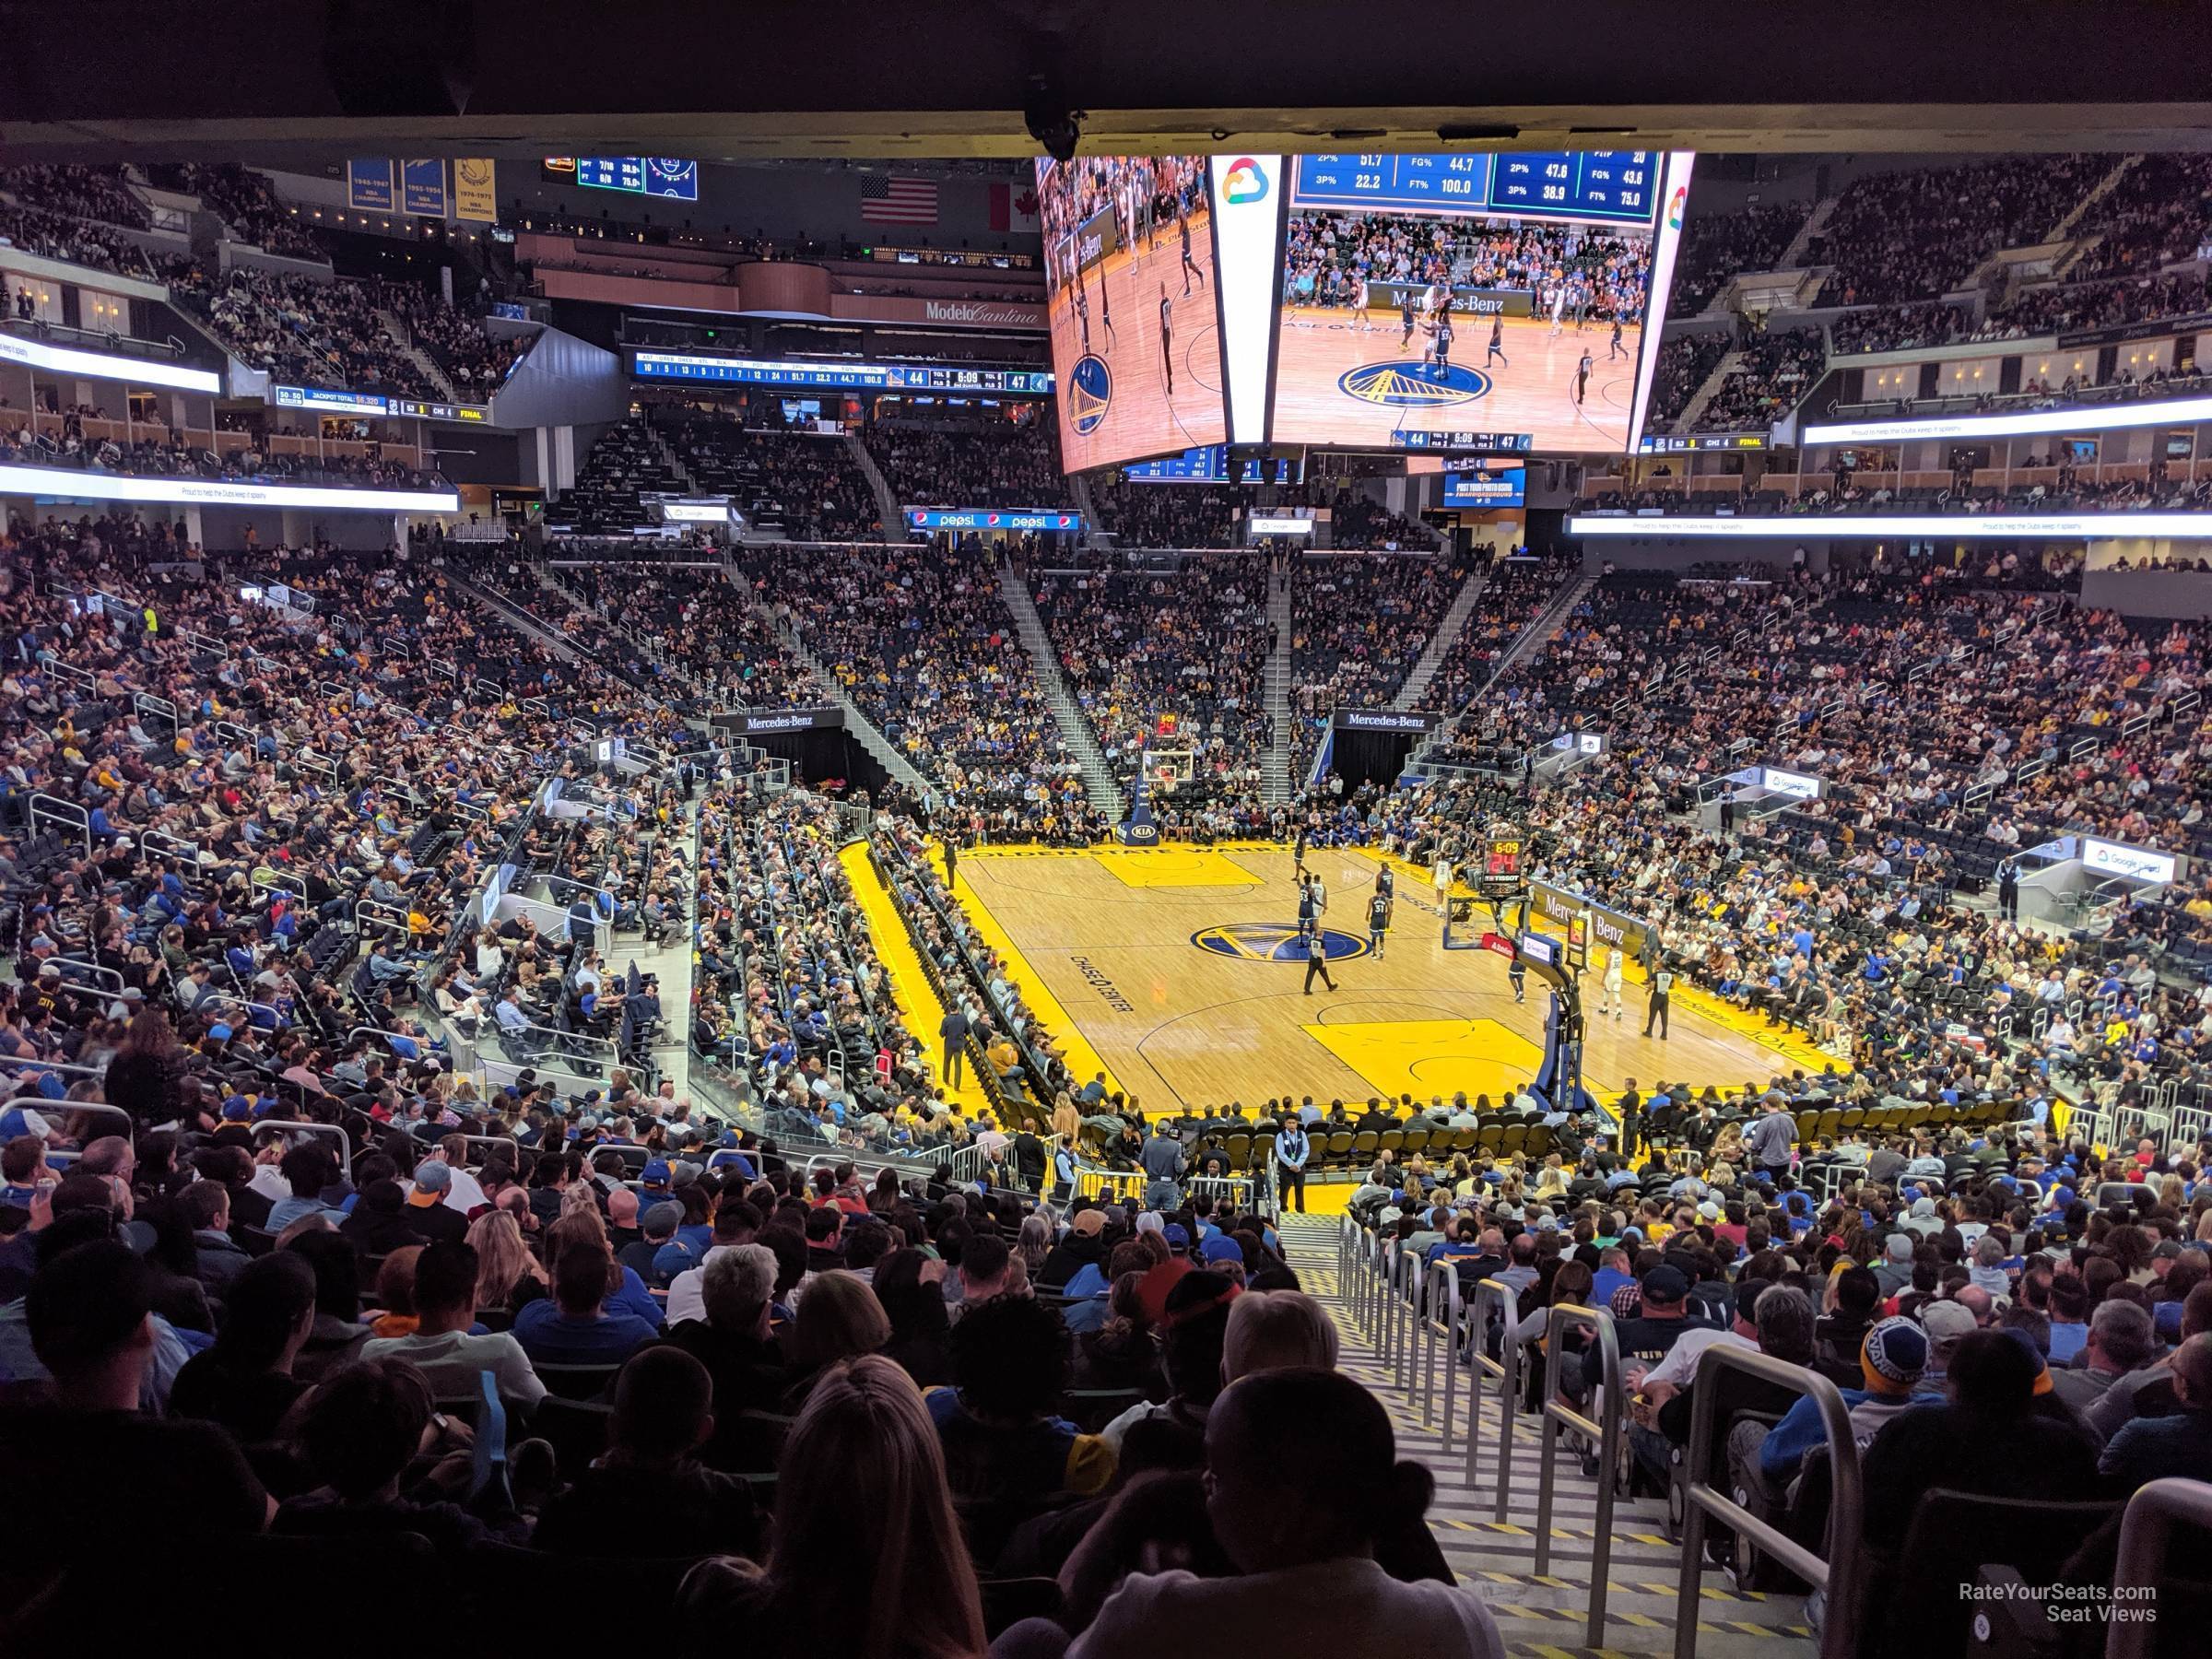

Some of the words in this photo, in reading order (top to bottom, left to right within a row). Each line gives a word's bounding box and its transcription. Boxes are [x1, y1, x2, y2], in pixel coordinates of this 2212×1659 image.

[1360, 155, 1382, 166] 51.7
[1411, 158, 1432, 167] FG%
[1450, 158, 1474, 171] 44.7
[1633, 152, 1645, 164] 20
[1510, 164, 1529, 173] 2P%
[1546, 164, 1568, 178] 47.6
[1592, 171, 1609, 180] FG%
[1623, 171, 1642, 184] 43.6
[1315, 175, 1336, 184] 3P%
[1355, 174, 1381, 189] 22.2
[1409, 180, 1429, 189] FT%
[1441, 179, 1471, 194] 100.0
[1508, 186, 1527, 195] 3P%
[1543, 186, 1565, 200] 38.9
[1589, 192, 1606, 201] FT%
[1621, 193, 1640, 206] 75.0
[926, 301, 973, 321] Modelo
[972, 302, 1039, 324] Cantina
[644, 363, 652, 371] 10
[682, 365, 689, 374] 13
[754, 371, 761, 379] 12
[771, 371, 781, 380] 24
[792, 372, 805, 381] 51.7
[816, 373, 831, 382] 22.2
[841, 374, 855, 383] 44.7
[865, 375, 882, 384] 100.0
[910, 371, 923, 384] 44
[958, 371, 978, 383] 6:09
[1012, 375, 1025, 388] 47
[312, 393, 336, 401] JACKPOT
[461, 409, 482, 418] FINAL
[1411, 433, 1423, 444] 44
[1454, 433, 1473, 443] 6:09
[1502, 436, 1513, 447] 47
[1724, 439, 1729, 447] 4
[1457, 483, 1468, 492] POST
[1469, 483, 1482, 492] YOUR
[1483, 483, 1498, 492] PHOTO
[940, 514, 975, 527] pepsi
[1012, 516, 1047, 528] pepsi
[747, 715, 813, 730] Mercedes-Benz
[1161, 714, 1175, 723] 6:09
[1349, 713, 1426, 727] Mercedes-Benz
[1135, 828, 1152, 836] KIA
[1496, 842, 1519, 853] 6:09
[1490, 853, 1516, 873] 24
[2111, 853, 2136, 868] Google
[1070, 957, 1105, 979] CHASE
[1097, 987, 1135, 1013] CENTER
